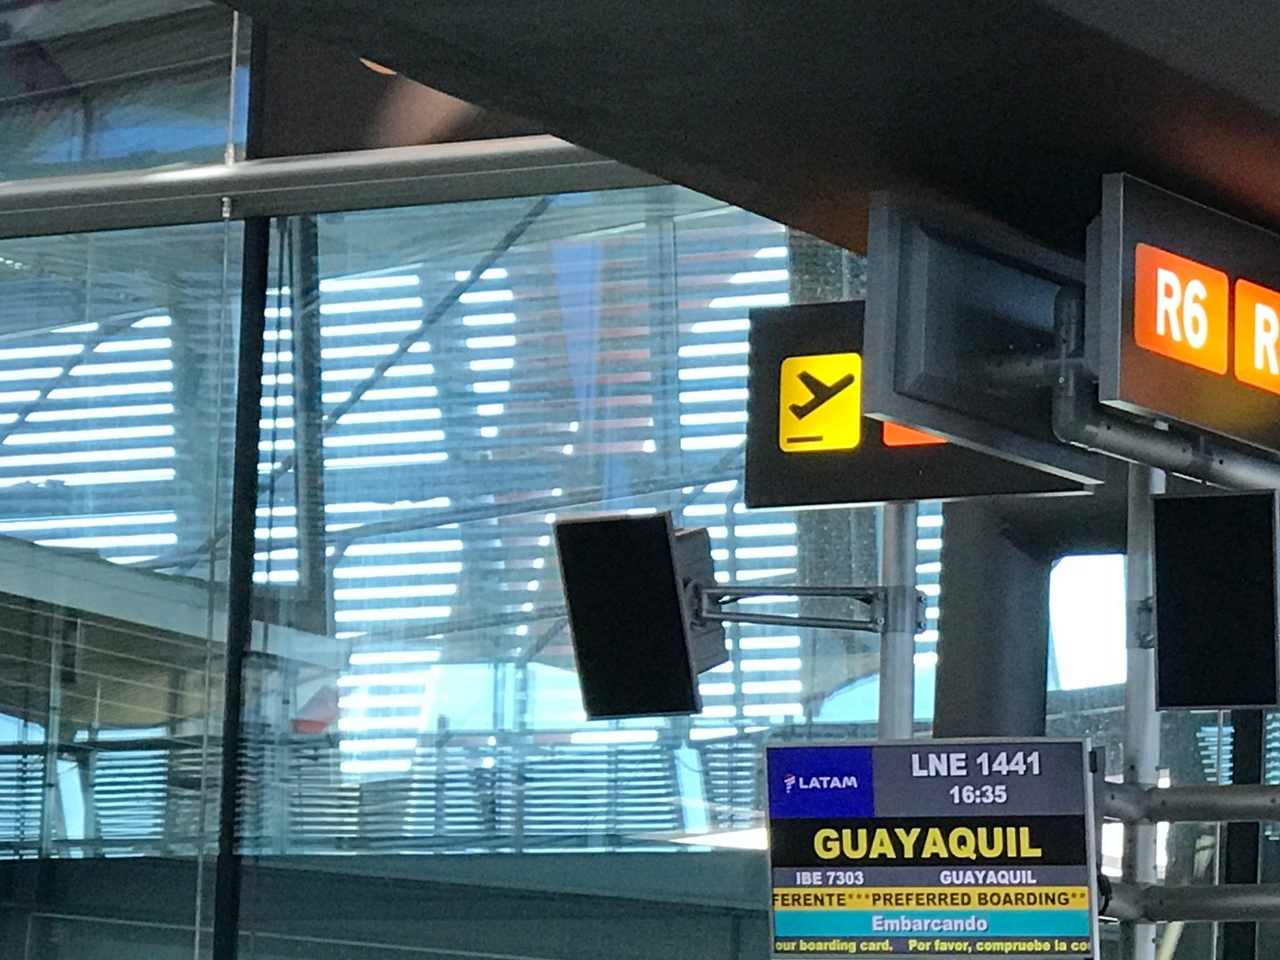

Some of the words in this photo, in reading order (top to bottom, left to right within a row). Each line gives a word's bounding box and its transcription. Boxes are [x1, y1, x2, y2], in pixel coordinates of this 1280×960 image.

[1155, 267, 1208, 349] R6
[911, 753, 967, 778] LNE
[976, 751, 1042, 776] 1441
[799, 776, 859, 790] LATAM
[949, 785, 1008, 804] 16:35
[813, 826, 1043, 861] GUAYAQUIL
[796, 871, 823, 886] IBE
[826, 871, 864, 886] 7303
[939, 869, 1038, 886] GUAYAQUIL
[872, 915, 989, 932] Embarcando
[800, 939, 857, 953] boarding
[859, 939, 893, 952] card.
[908, 939, 932, 951] Por
[934, 938, 972, 953] favor,
[1054, 938, 1067, 951] la
